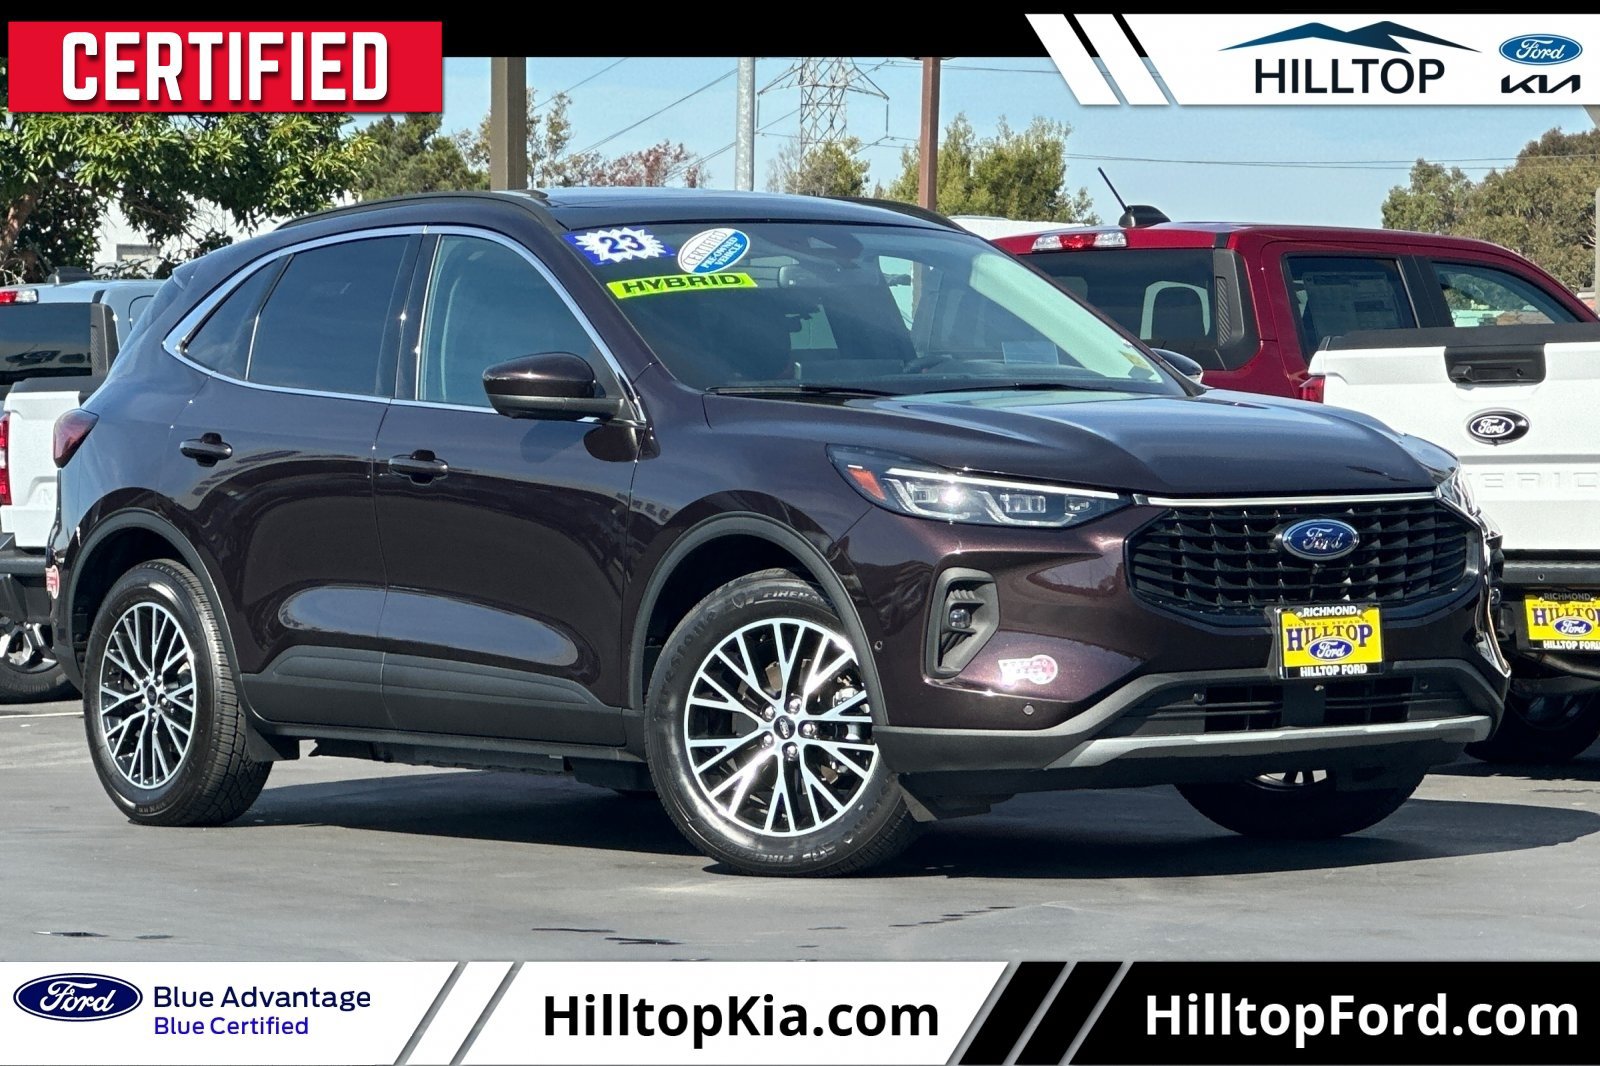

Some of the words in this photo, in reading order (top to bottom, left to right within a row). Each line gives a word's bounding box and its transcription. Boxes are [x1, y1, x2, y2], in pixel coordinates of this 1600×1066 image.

[598, 234, 646, 254] 23
[683, 230, 728, 266] CERTIFIED
[623, 273, 742, 295] HYBRID
[1477, 418, 1507, 434] Ford
[1302, 527, 1344, 550] Ford
[1544, 592, 1591, 601] RICHMOND
[1303, 605, 1357, 617] RICHMOND
[1532, 607, 1600, 627] HILLTO
[1560, 620, 1587, 634] Ford
[1286, 624, 1373, 652] HILLTOP
[1543, 640, 1578, 650] HILLTOP
[1316, 641, 1346, 658] Ford
[1300, 665, 1340, 677] HILLTOP
[1341, 664, 1368, 675] FORD
